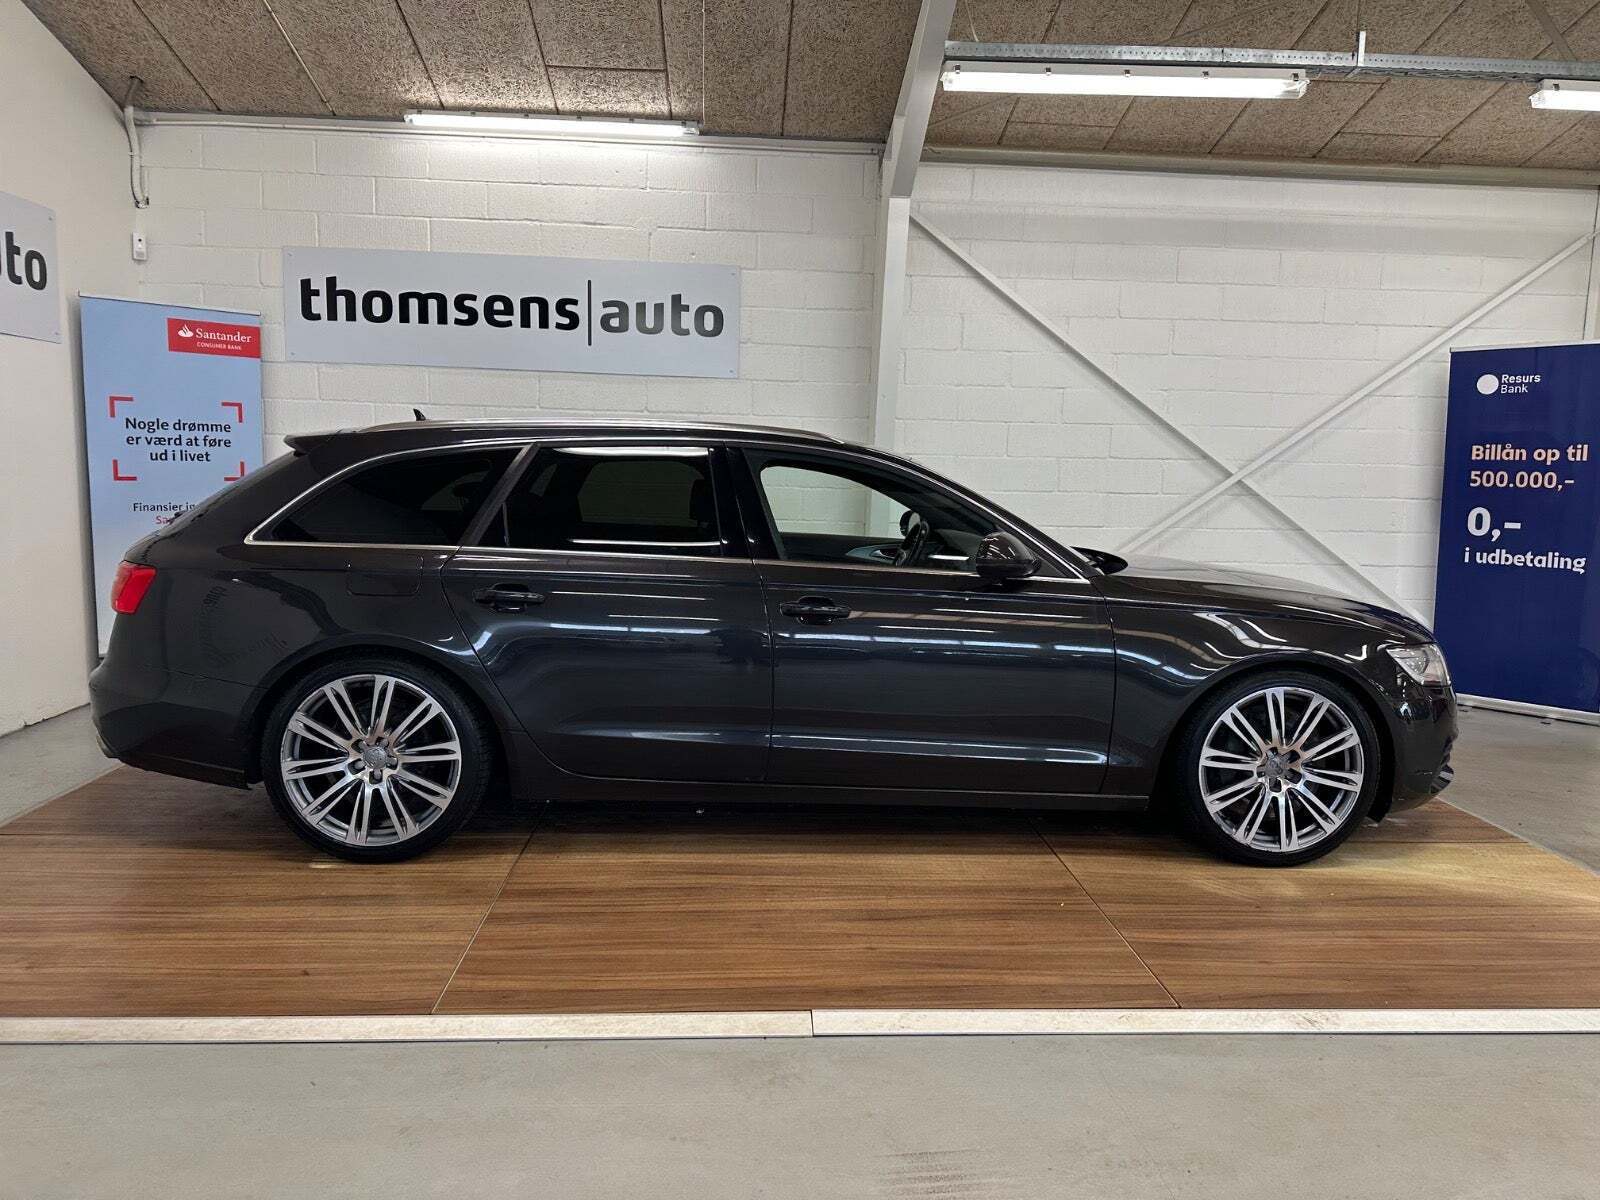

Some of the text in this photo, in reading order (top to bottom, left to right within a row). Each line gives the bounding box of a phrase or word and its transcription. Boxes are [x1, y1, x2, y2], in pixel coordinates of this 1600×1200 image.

[0, 231, 48, 291] to
[299, 275, 725, 338] thomsens auto
[195, 327, 252, 343] Santander
[196, 341, 242, 351] CONSUMER BANK
[1501, 374, 1541, 384] Resurs
[1500, 384, 1529, 394] Bank
[125, 417, 232, 434] Nogle drømme
[126, 434, 232, 448] er værd at føre
[150, 449, 211, 462] ud i livet
[1471, 443, 1589, 466] Billån op til
[133, 501, 183, 512] Finansier
[1464, 547, 1587, 575] i udbetaling
